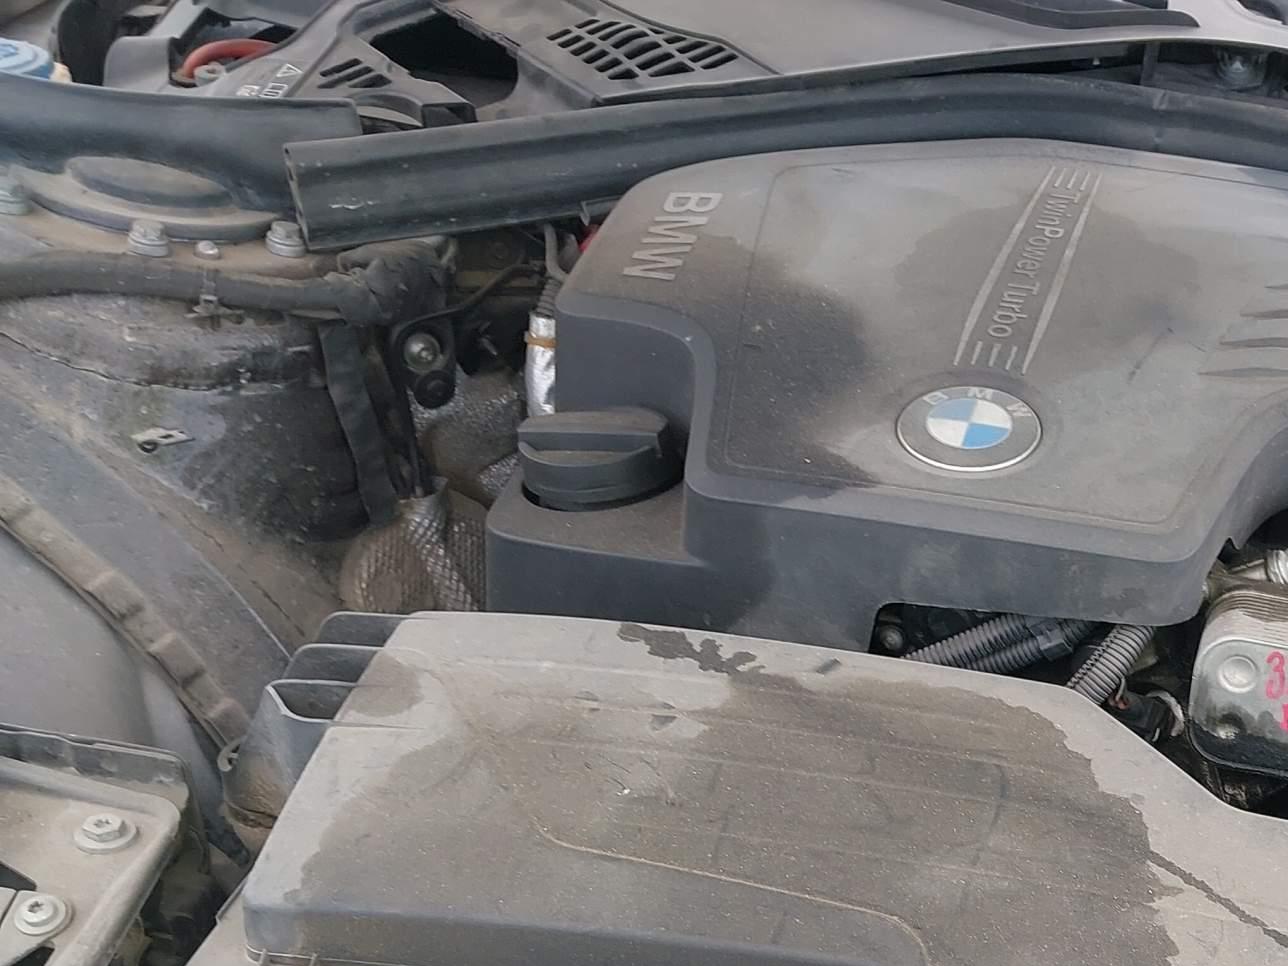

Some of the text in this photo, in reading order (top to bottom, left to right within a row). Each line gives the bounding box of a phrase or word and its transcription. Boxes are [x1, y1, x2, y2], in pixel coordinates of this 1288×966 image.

[623, 191, 723, 281] BMW
[986, 191, 1081, 338] TwinPower Turbo
